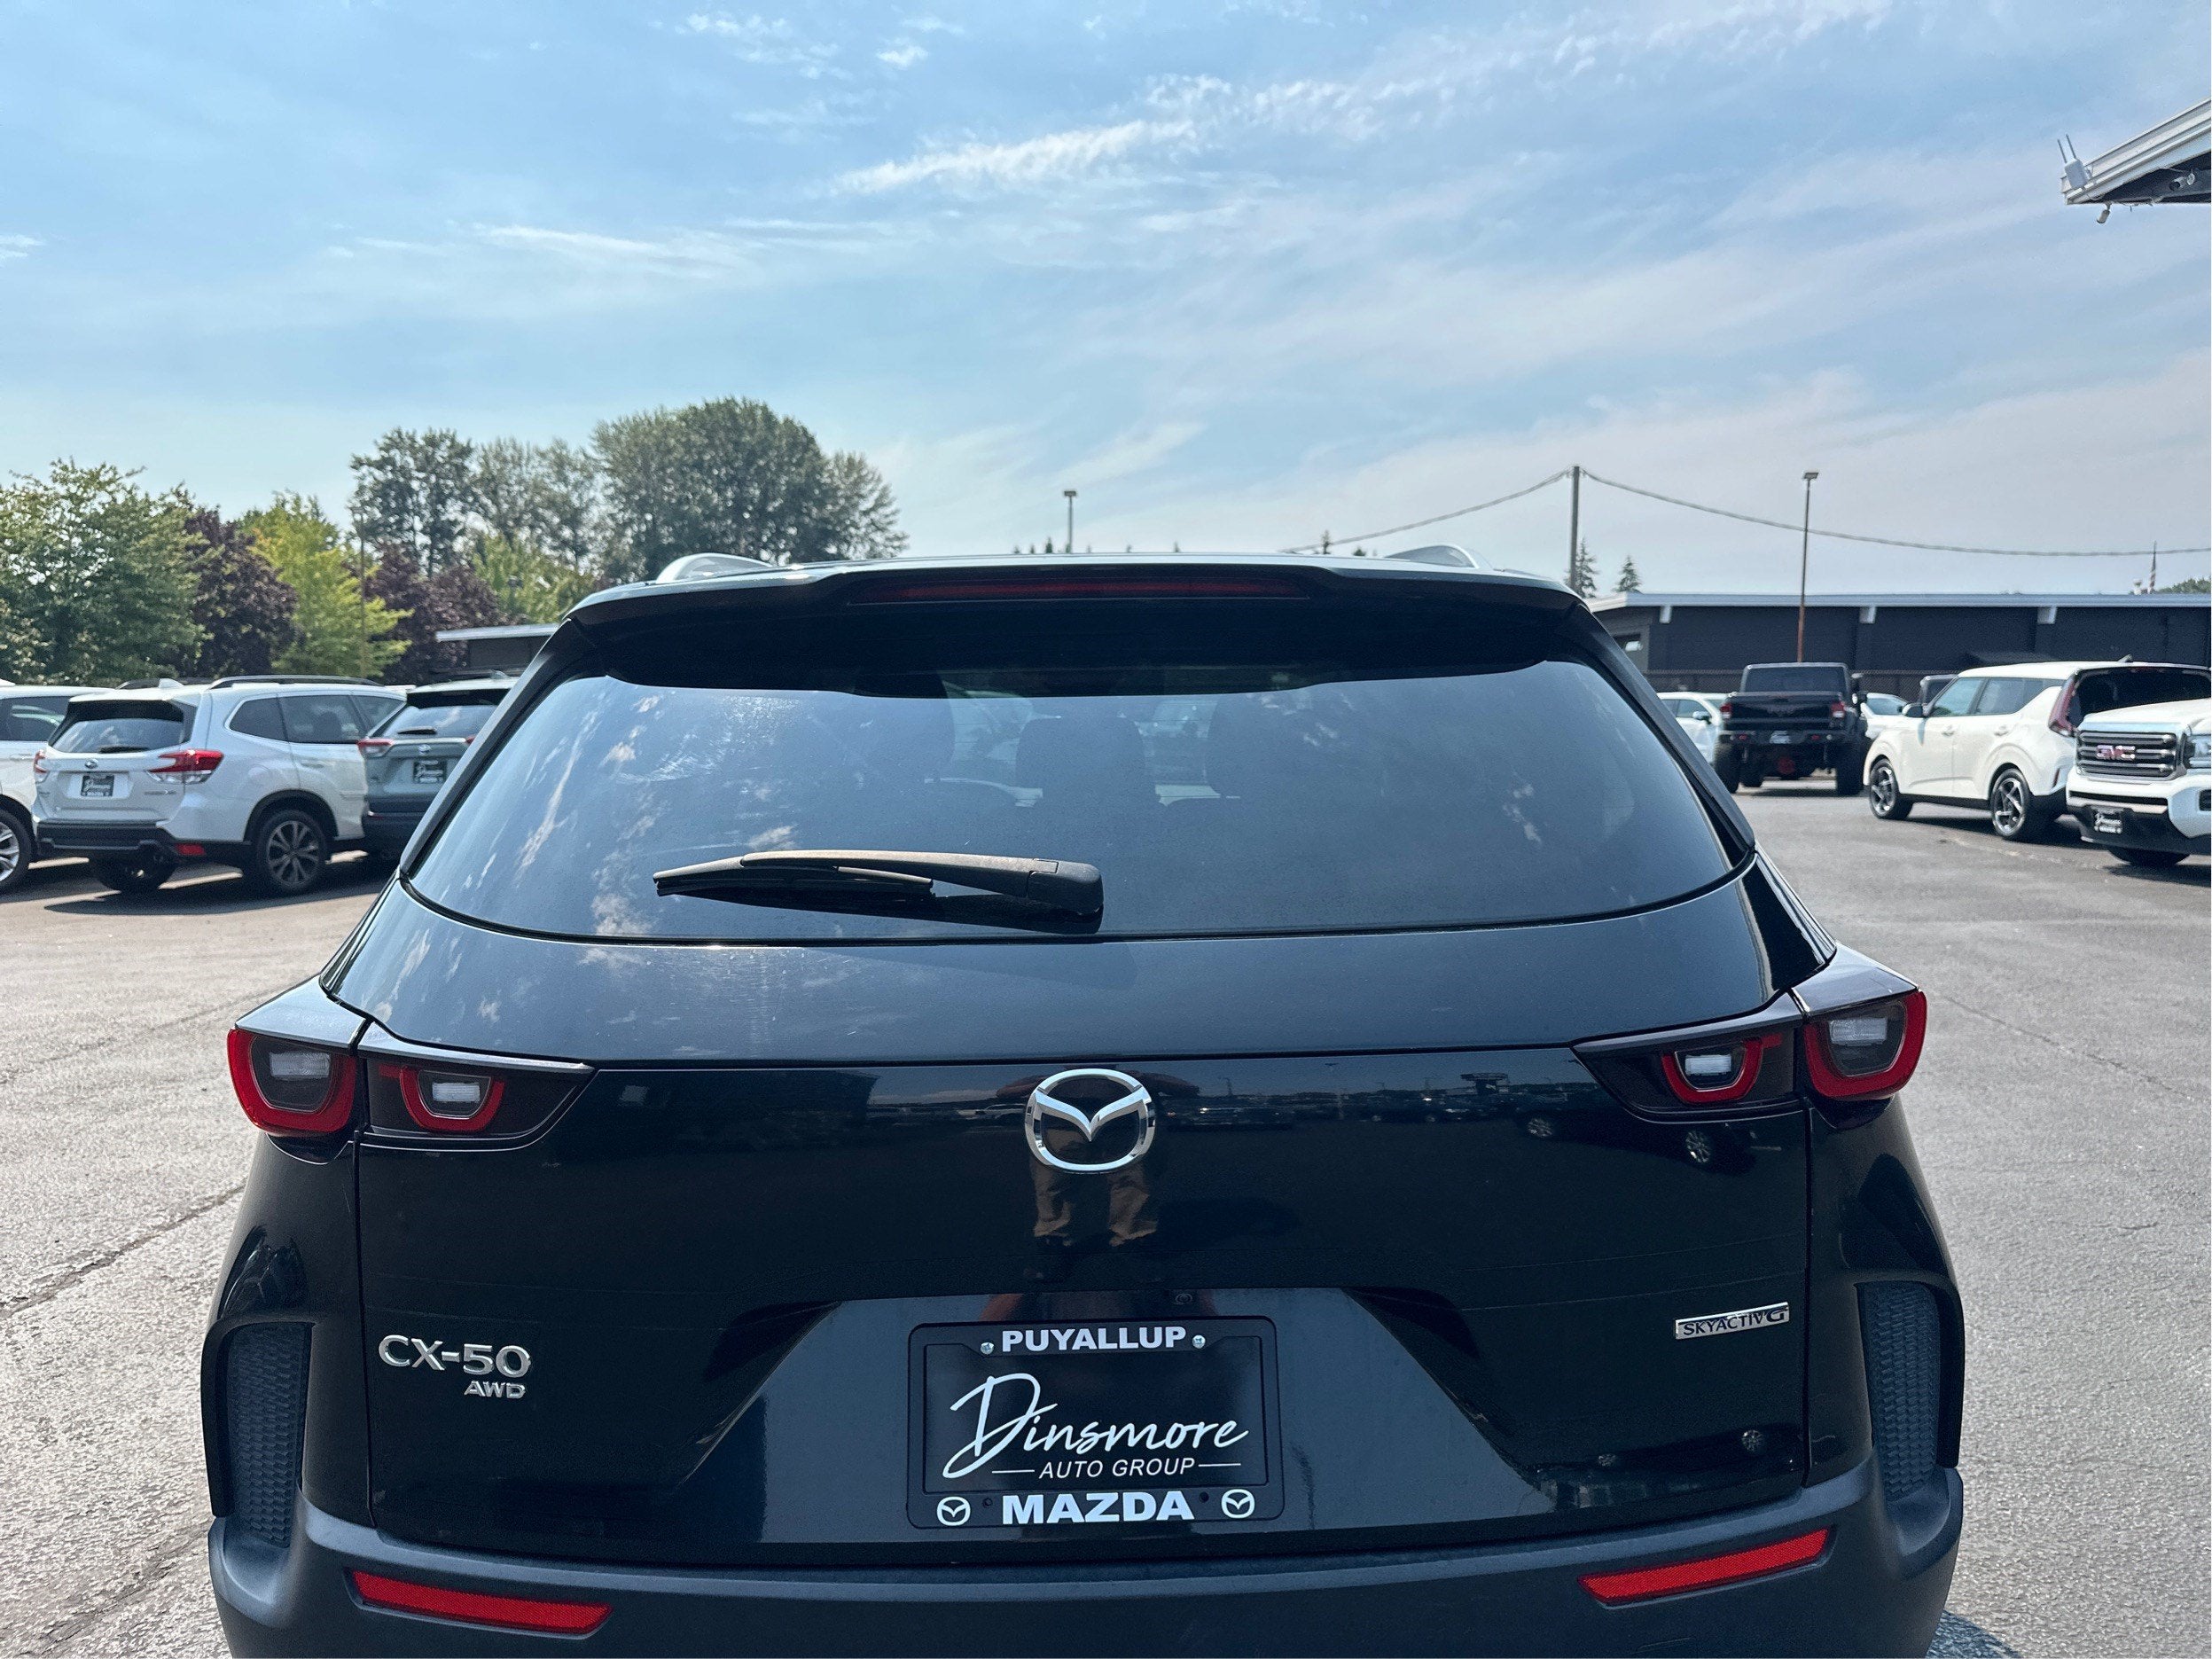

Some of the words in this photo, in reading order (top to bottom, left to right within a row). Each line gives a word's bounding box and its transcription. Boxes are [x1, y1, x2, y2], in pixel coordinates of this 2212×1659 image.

[2096, 745, 2136, 760] GMC
[1002, 1326, 1187, 1353] PUYALLUP
[379, 1334, 531, 1378] CX-50
[464, 1380, 527, 1399] AWD
[942, 1372, 1249, 1479] Dinsmore
[1038, 1460, 1104, 1480] AUTO
[1112, 1457, 1196, 1478] GROUP
[1002, 1491, 1195, 1525] MAZDA
